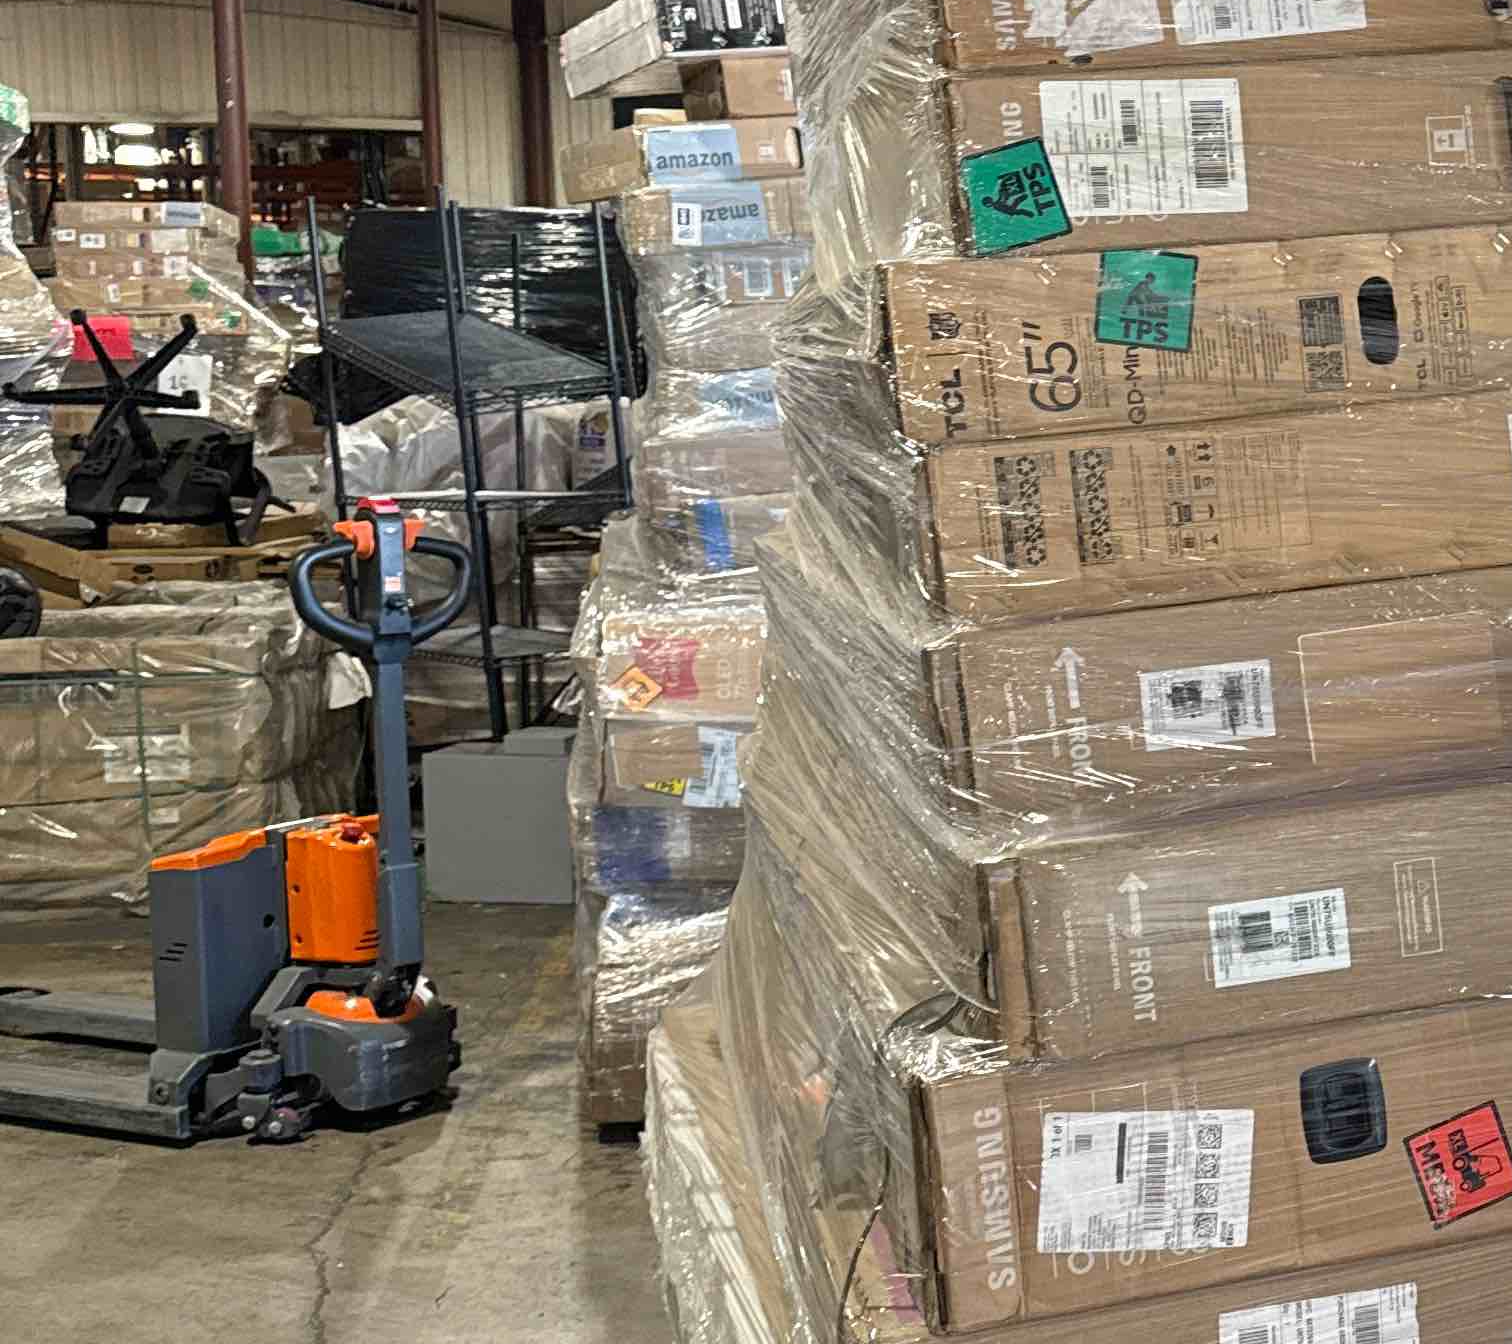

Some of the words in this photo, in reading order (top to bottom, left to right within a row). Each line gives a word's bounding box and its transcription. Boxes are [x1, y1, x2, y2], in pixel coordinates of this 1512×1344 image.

[655, 149, 734, 170] amazon
[1021, 162, 1057, 217] TPS
[700, 203, 760, 224] amaz
[1120, 318, 1170, 344] TPS
[941, 368, 967, 438] TCL
[1120, 345, 1147, 425] QD-Min
[1127, 946, 1157, 1022] FRONT
[973, 1106, 1018, 1291] SAMSUNG
